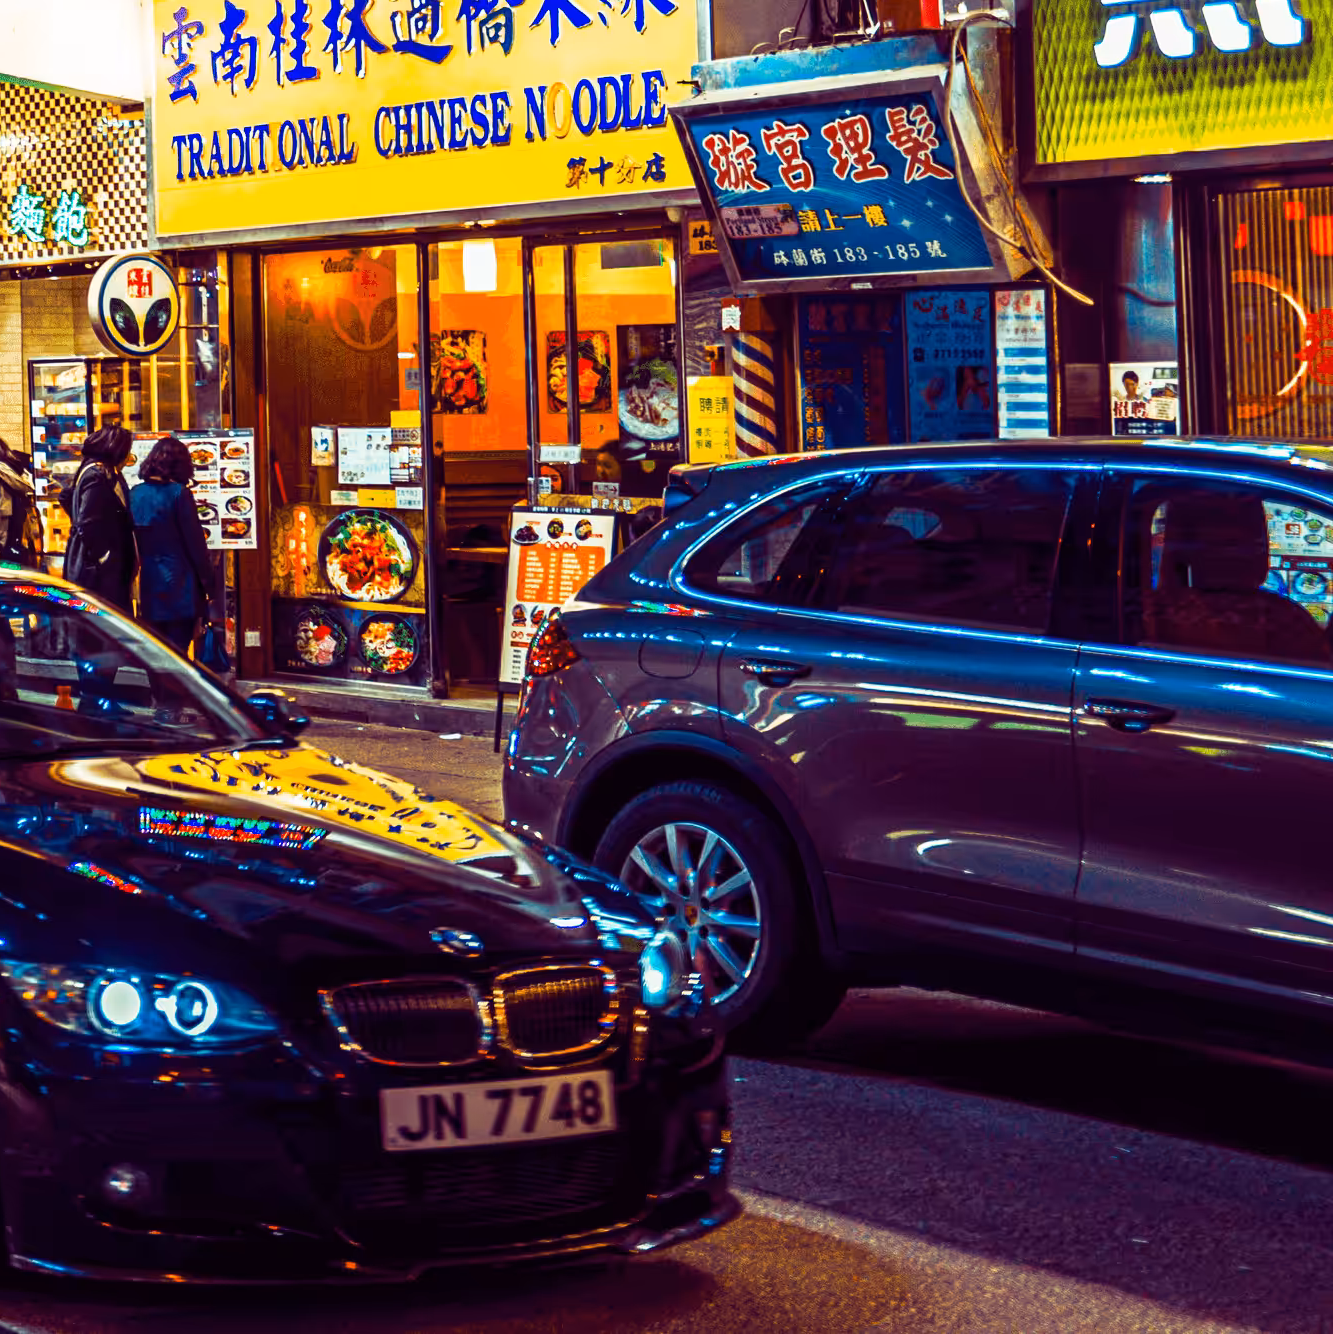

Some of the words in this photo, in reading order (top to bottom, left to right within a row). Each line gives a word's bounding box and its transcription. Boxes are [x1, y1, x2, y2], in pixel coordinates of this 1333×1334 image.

[374, 89, 512, 159] CHINESE
[703, 105, 955, 193] 璇宮理髮
[798, 204, 888, 233] 請上一樓
[399, 1092, 468, 1143] JN
[485, 1080, 603, 1137] 7748
